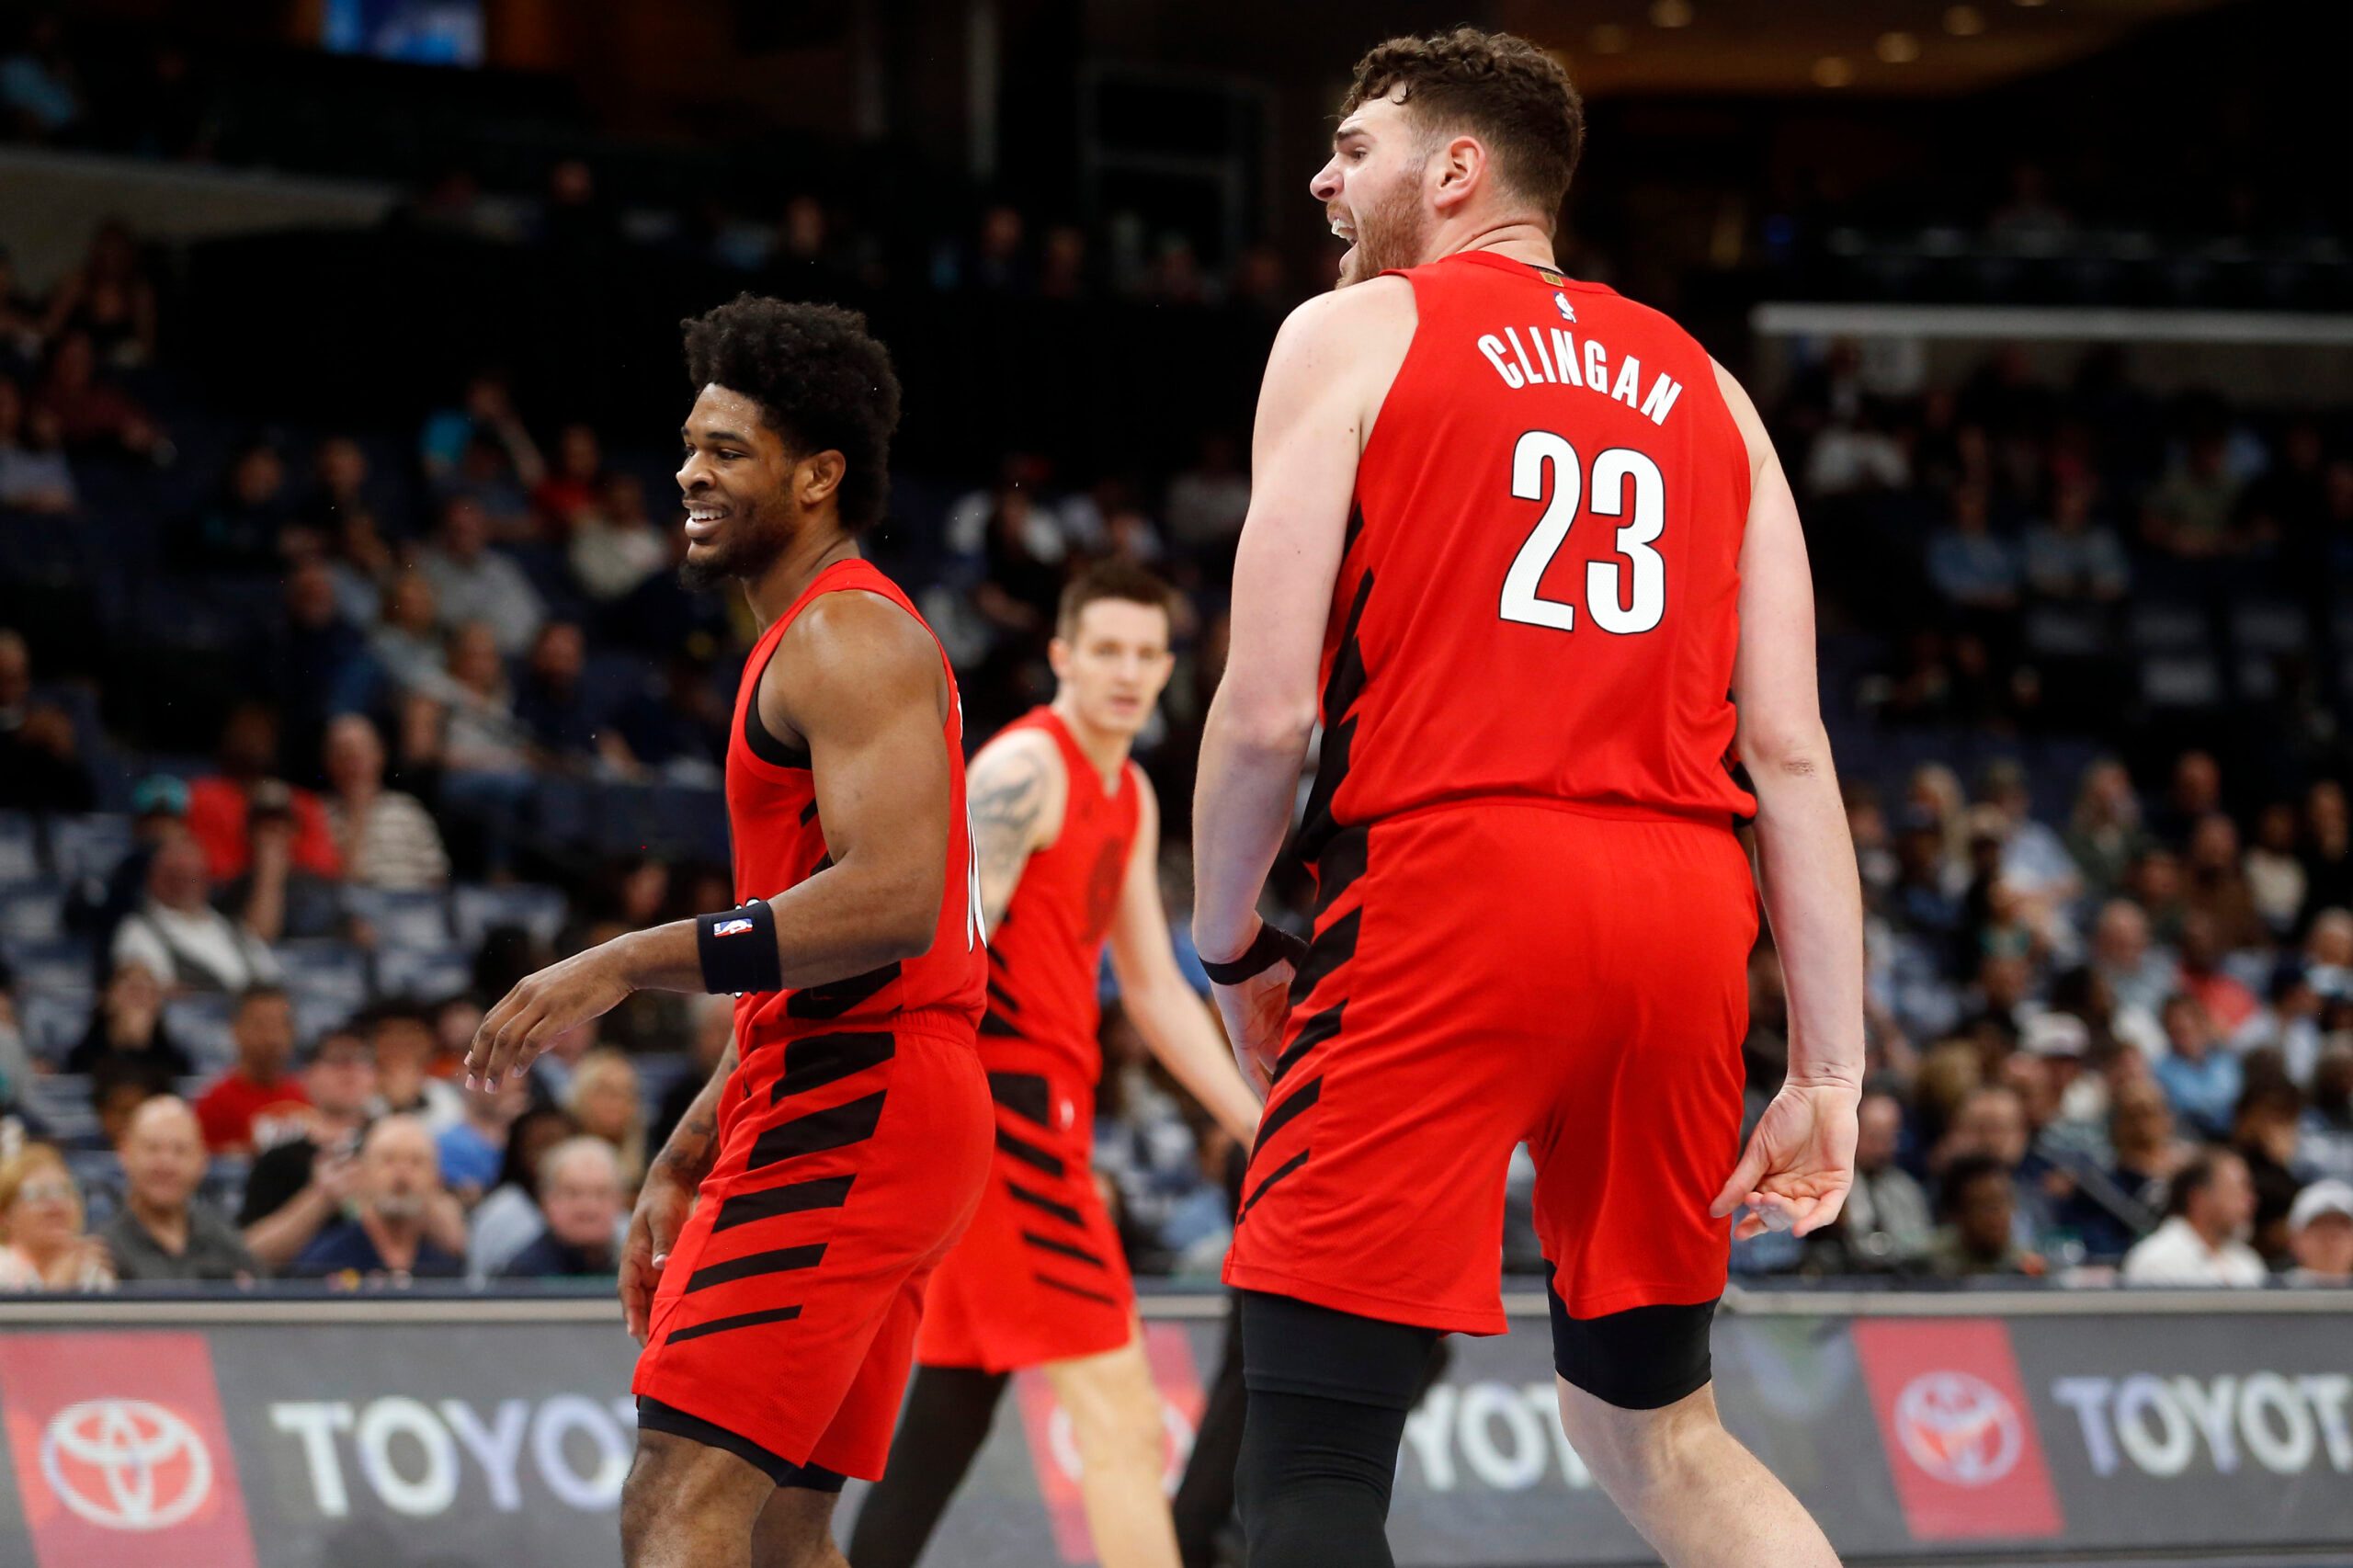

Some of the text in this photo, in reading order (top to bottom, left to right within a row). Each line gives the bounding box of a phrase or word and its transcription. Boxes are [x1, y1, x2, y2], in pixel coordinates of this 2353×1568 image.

[1477, 326, 1683, 426] CLINGAN
[1499, 429, 1665, 635] 23
[269, 1394, 638, 1517] TOYO
